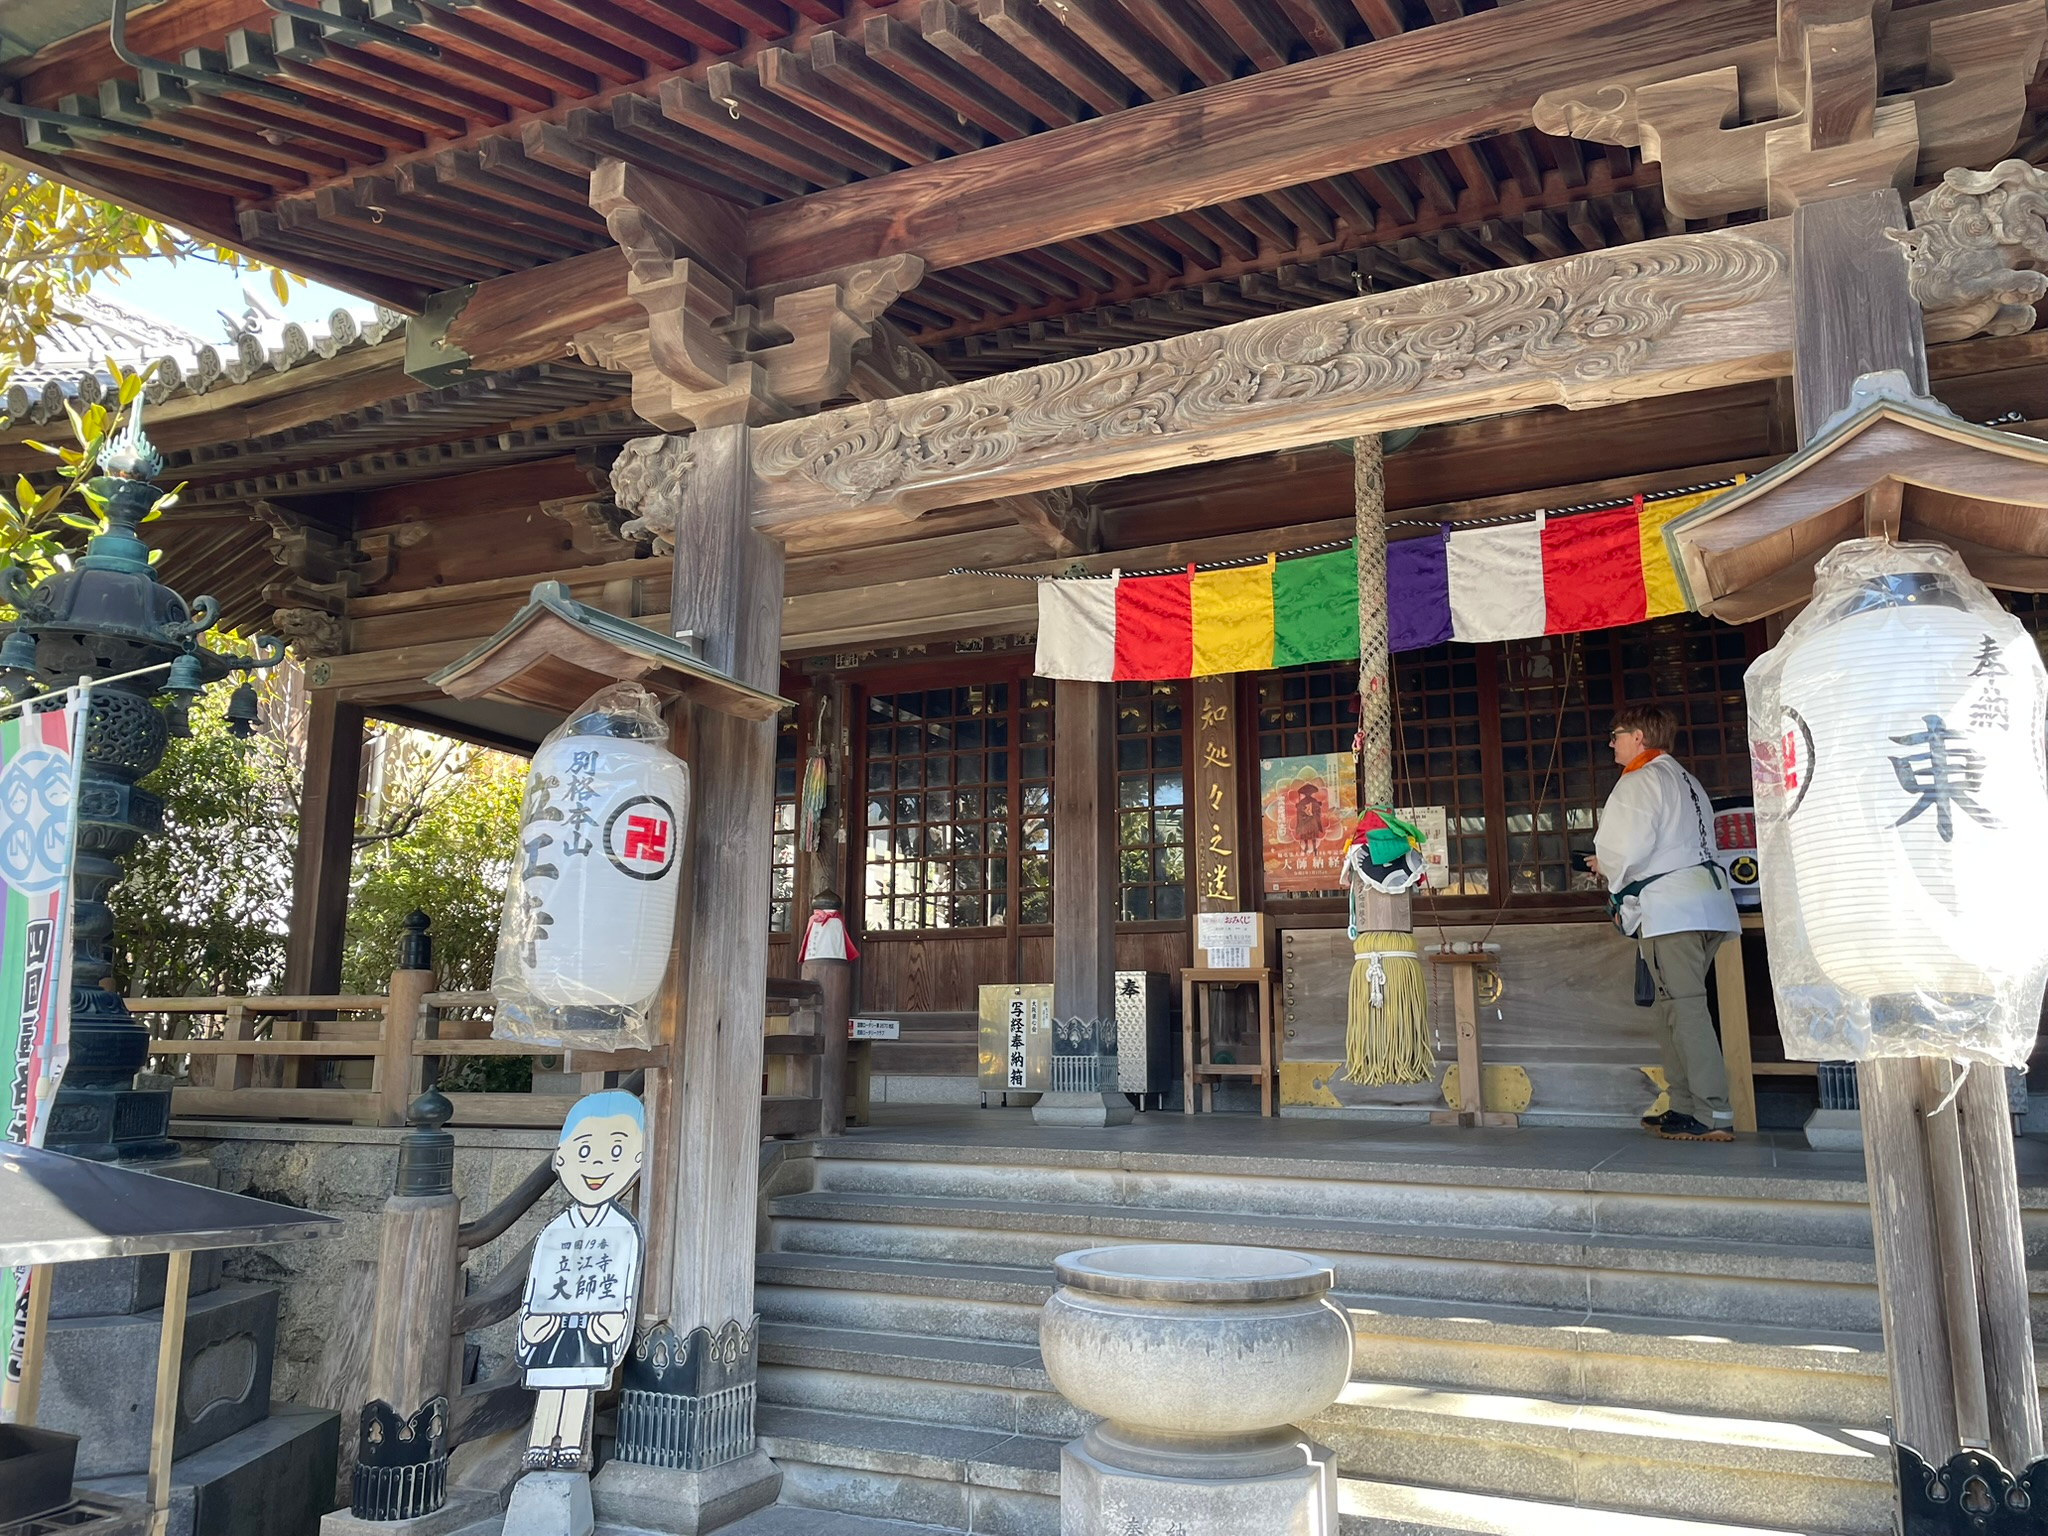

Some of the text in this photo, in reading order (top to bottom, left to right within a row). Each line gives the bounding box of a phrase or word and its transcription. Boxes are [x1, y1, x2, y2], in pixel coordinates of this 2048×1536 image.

[561, 750, 600, 857] 別格本山
[1224, 916, 1251, 925] おみくじ
[1120, 978, 1140, 999] 奉
[1010, 1001, 1025, 1086] 写経奉納箱
[556, 1253, 613, 1274] 立江寺
[549, 1274, 618, 1301] 大師堂
